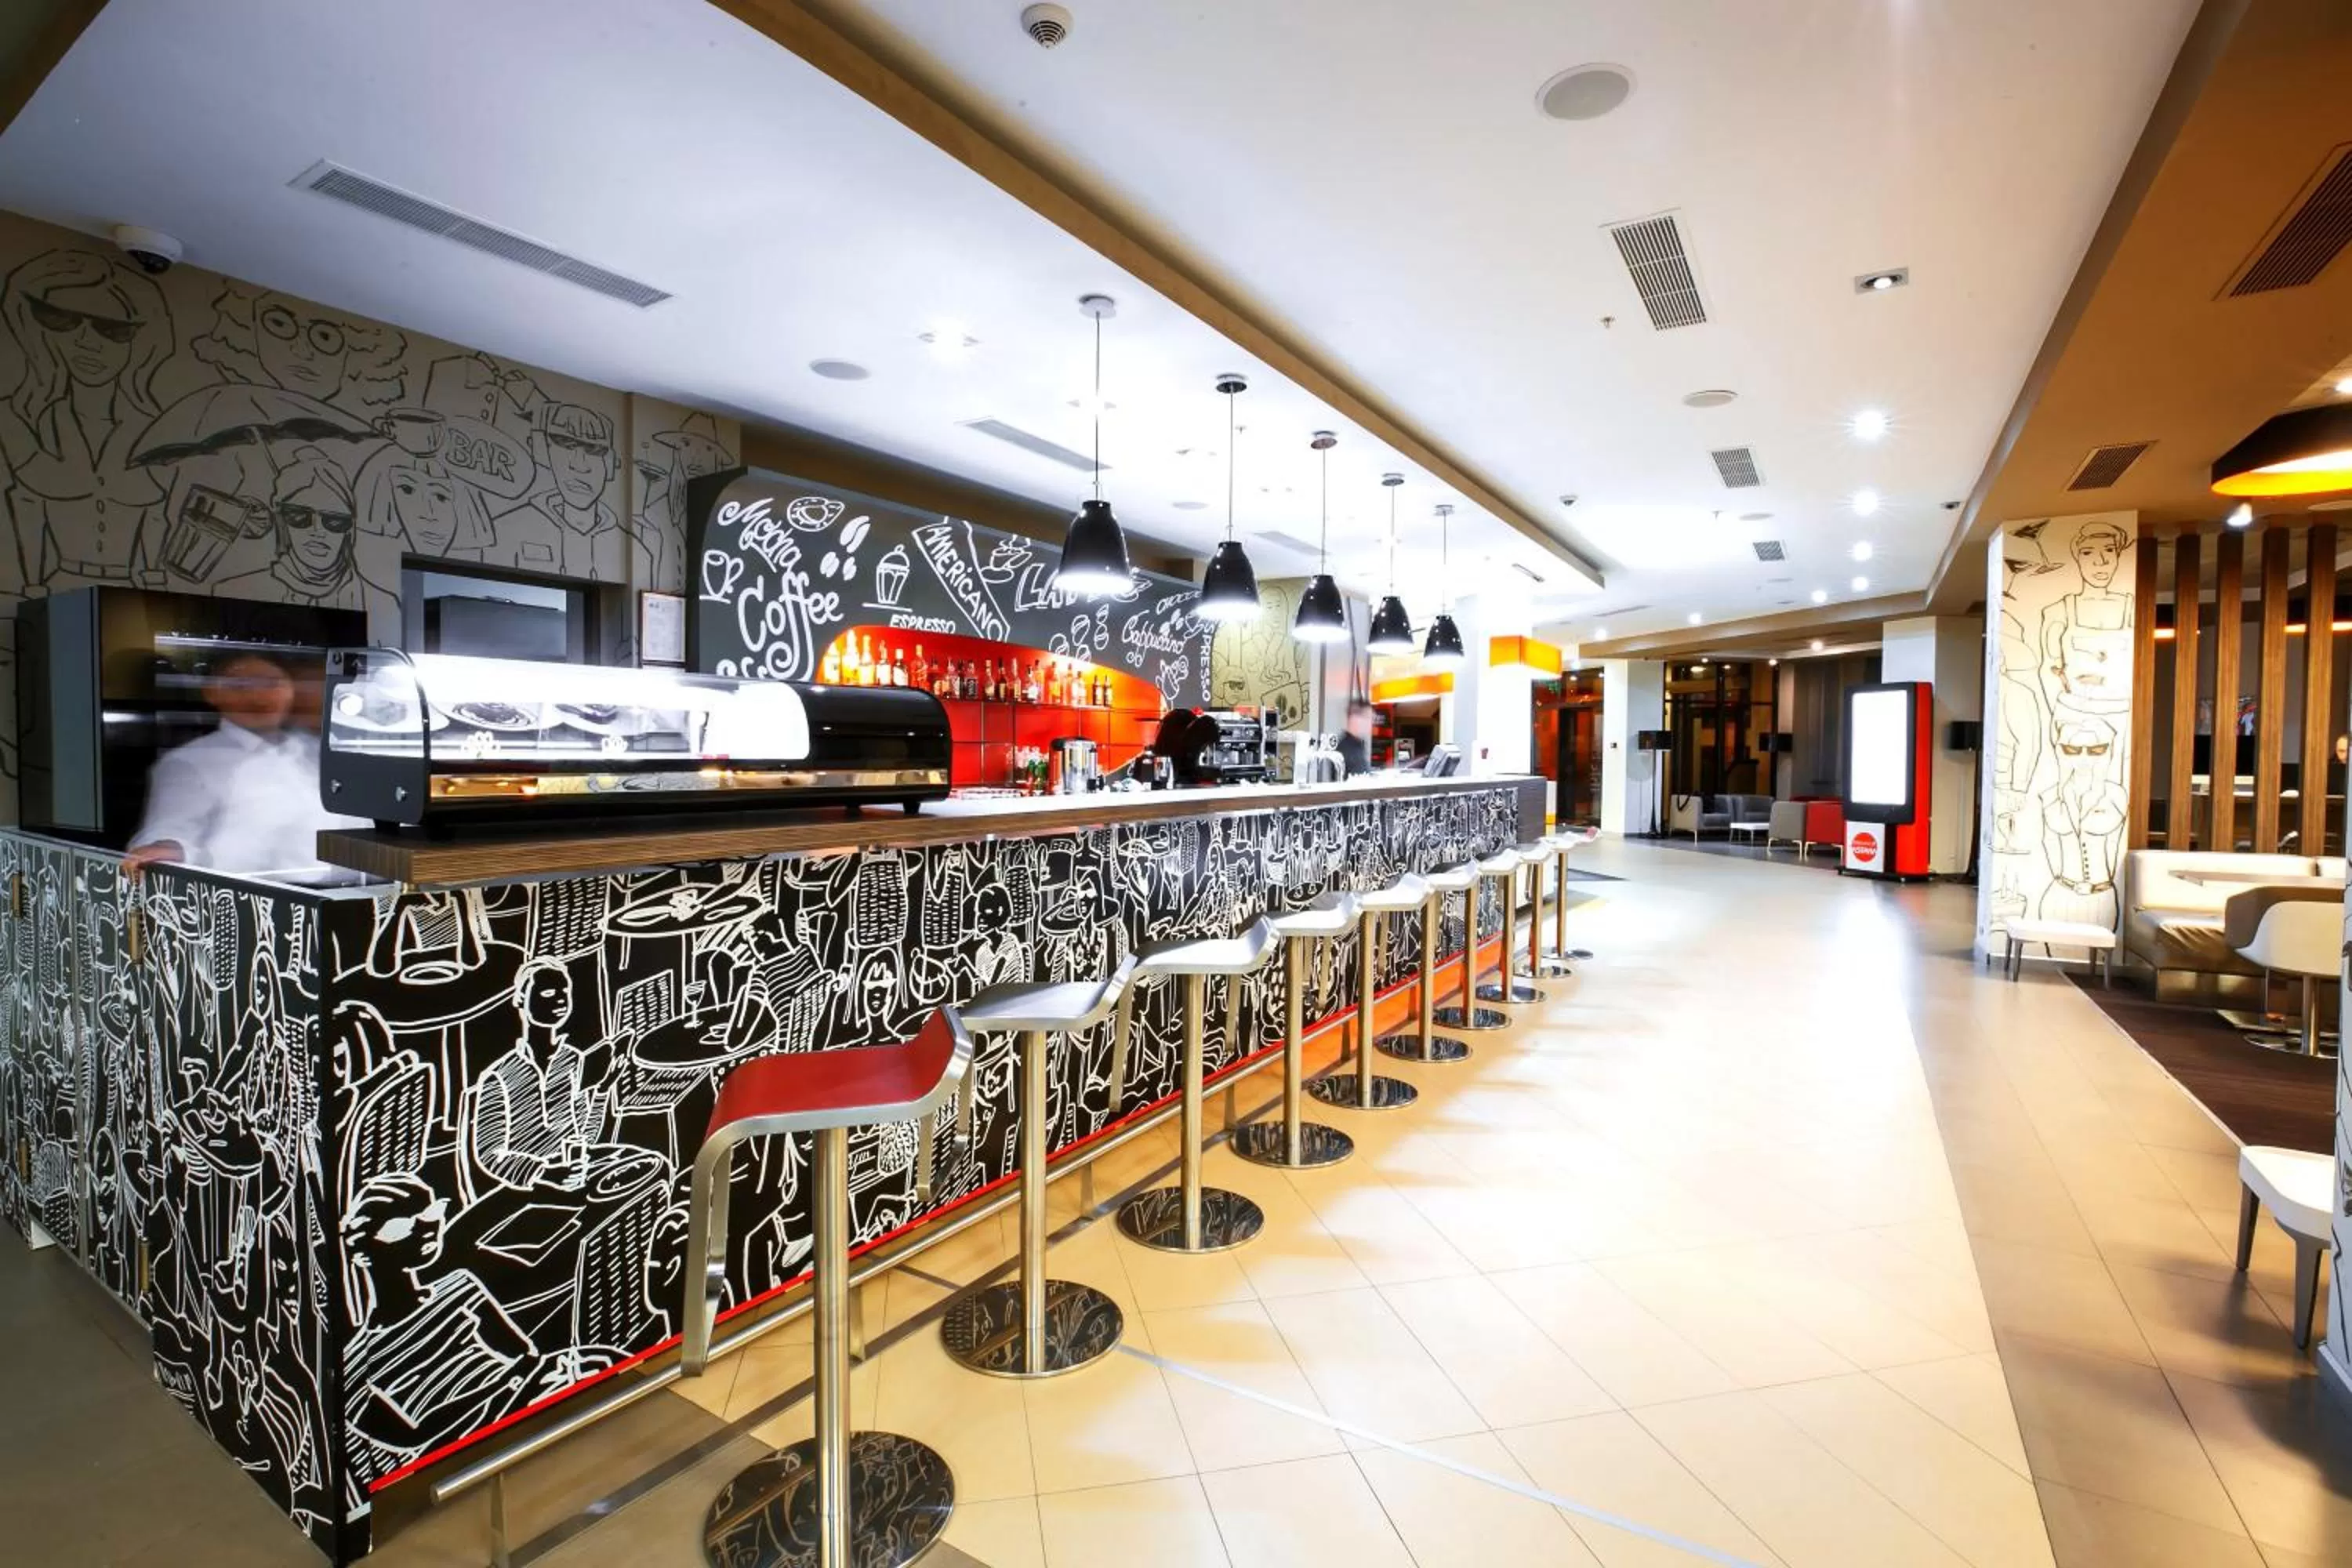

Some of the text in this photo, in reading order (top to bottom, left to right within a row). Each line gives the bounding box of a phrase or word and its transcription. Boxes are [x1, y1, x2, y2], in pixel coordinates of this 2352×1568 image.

[445, 427, 517, 483] BAR
[738, 570, 844, 681] Coffee
[889, 614, 956, 634] ESPRESSO
[1200, 620, 1214, 702] SPRESSO
